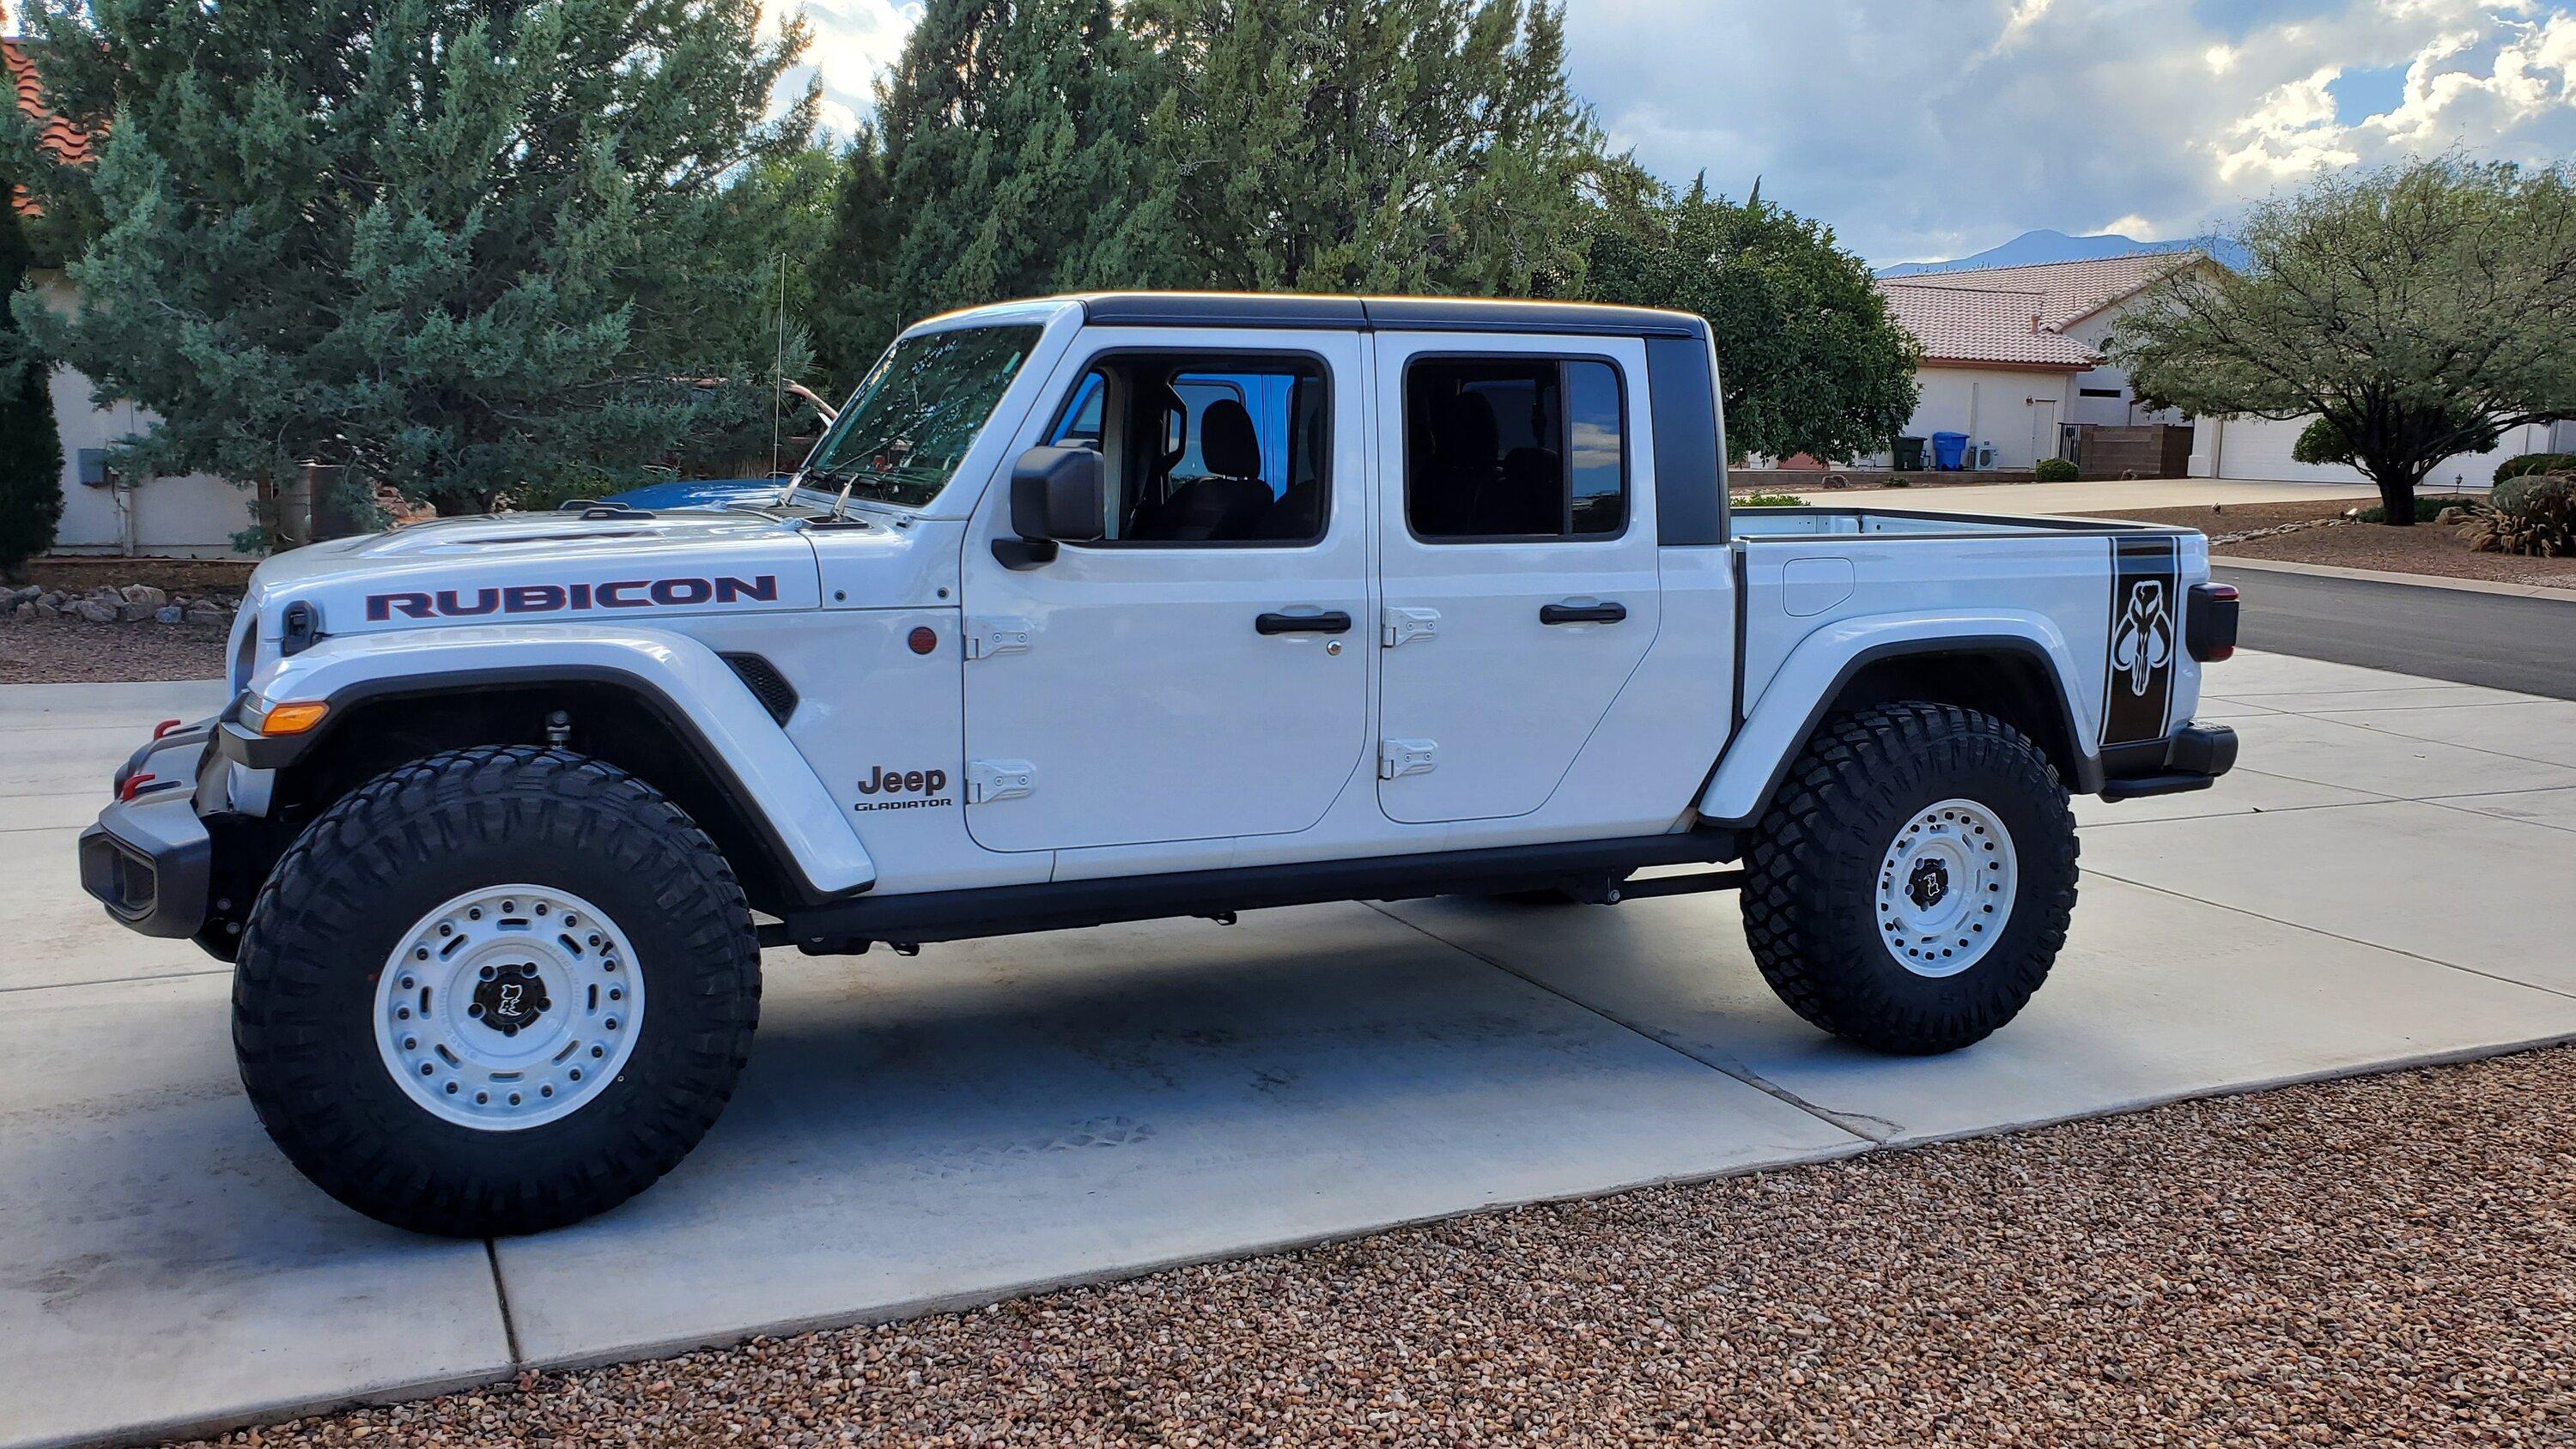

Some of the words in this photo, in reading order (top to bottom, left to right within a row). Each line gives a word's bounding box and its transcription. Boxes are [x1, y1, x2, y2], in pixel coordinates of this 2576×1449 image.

[366, 575, 778, 621] RUBICON
[858, 766, 946, 796] Jeep
[854, 798, 952, 811] GLADIATOR
